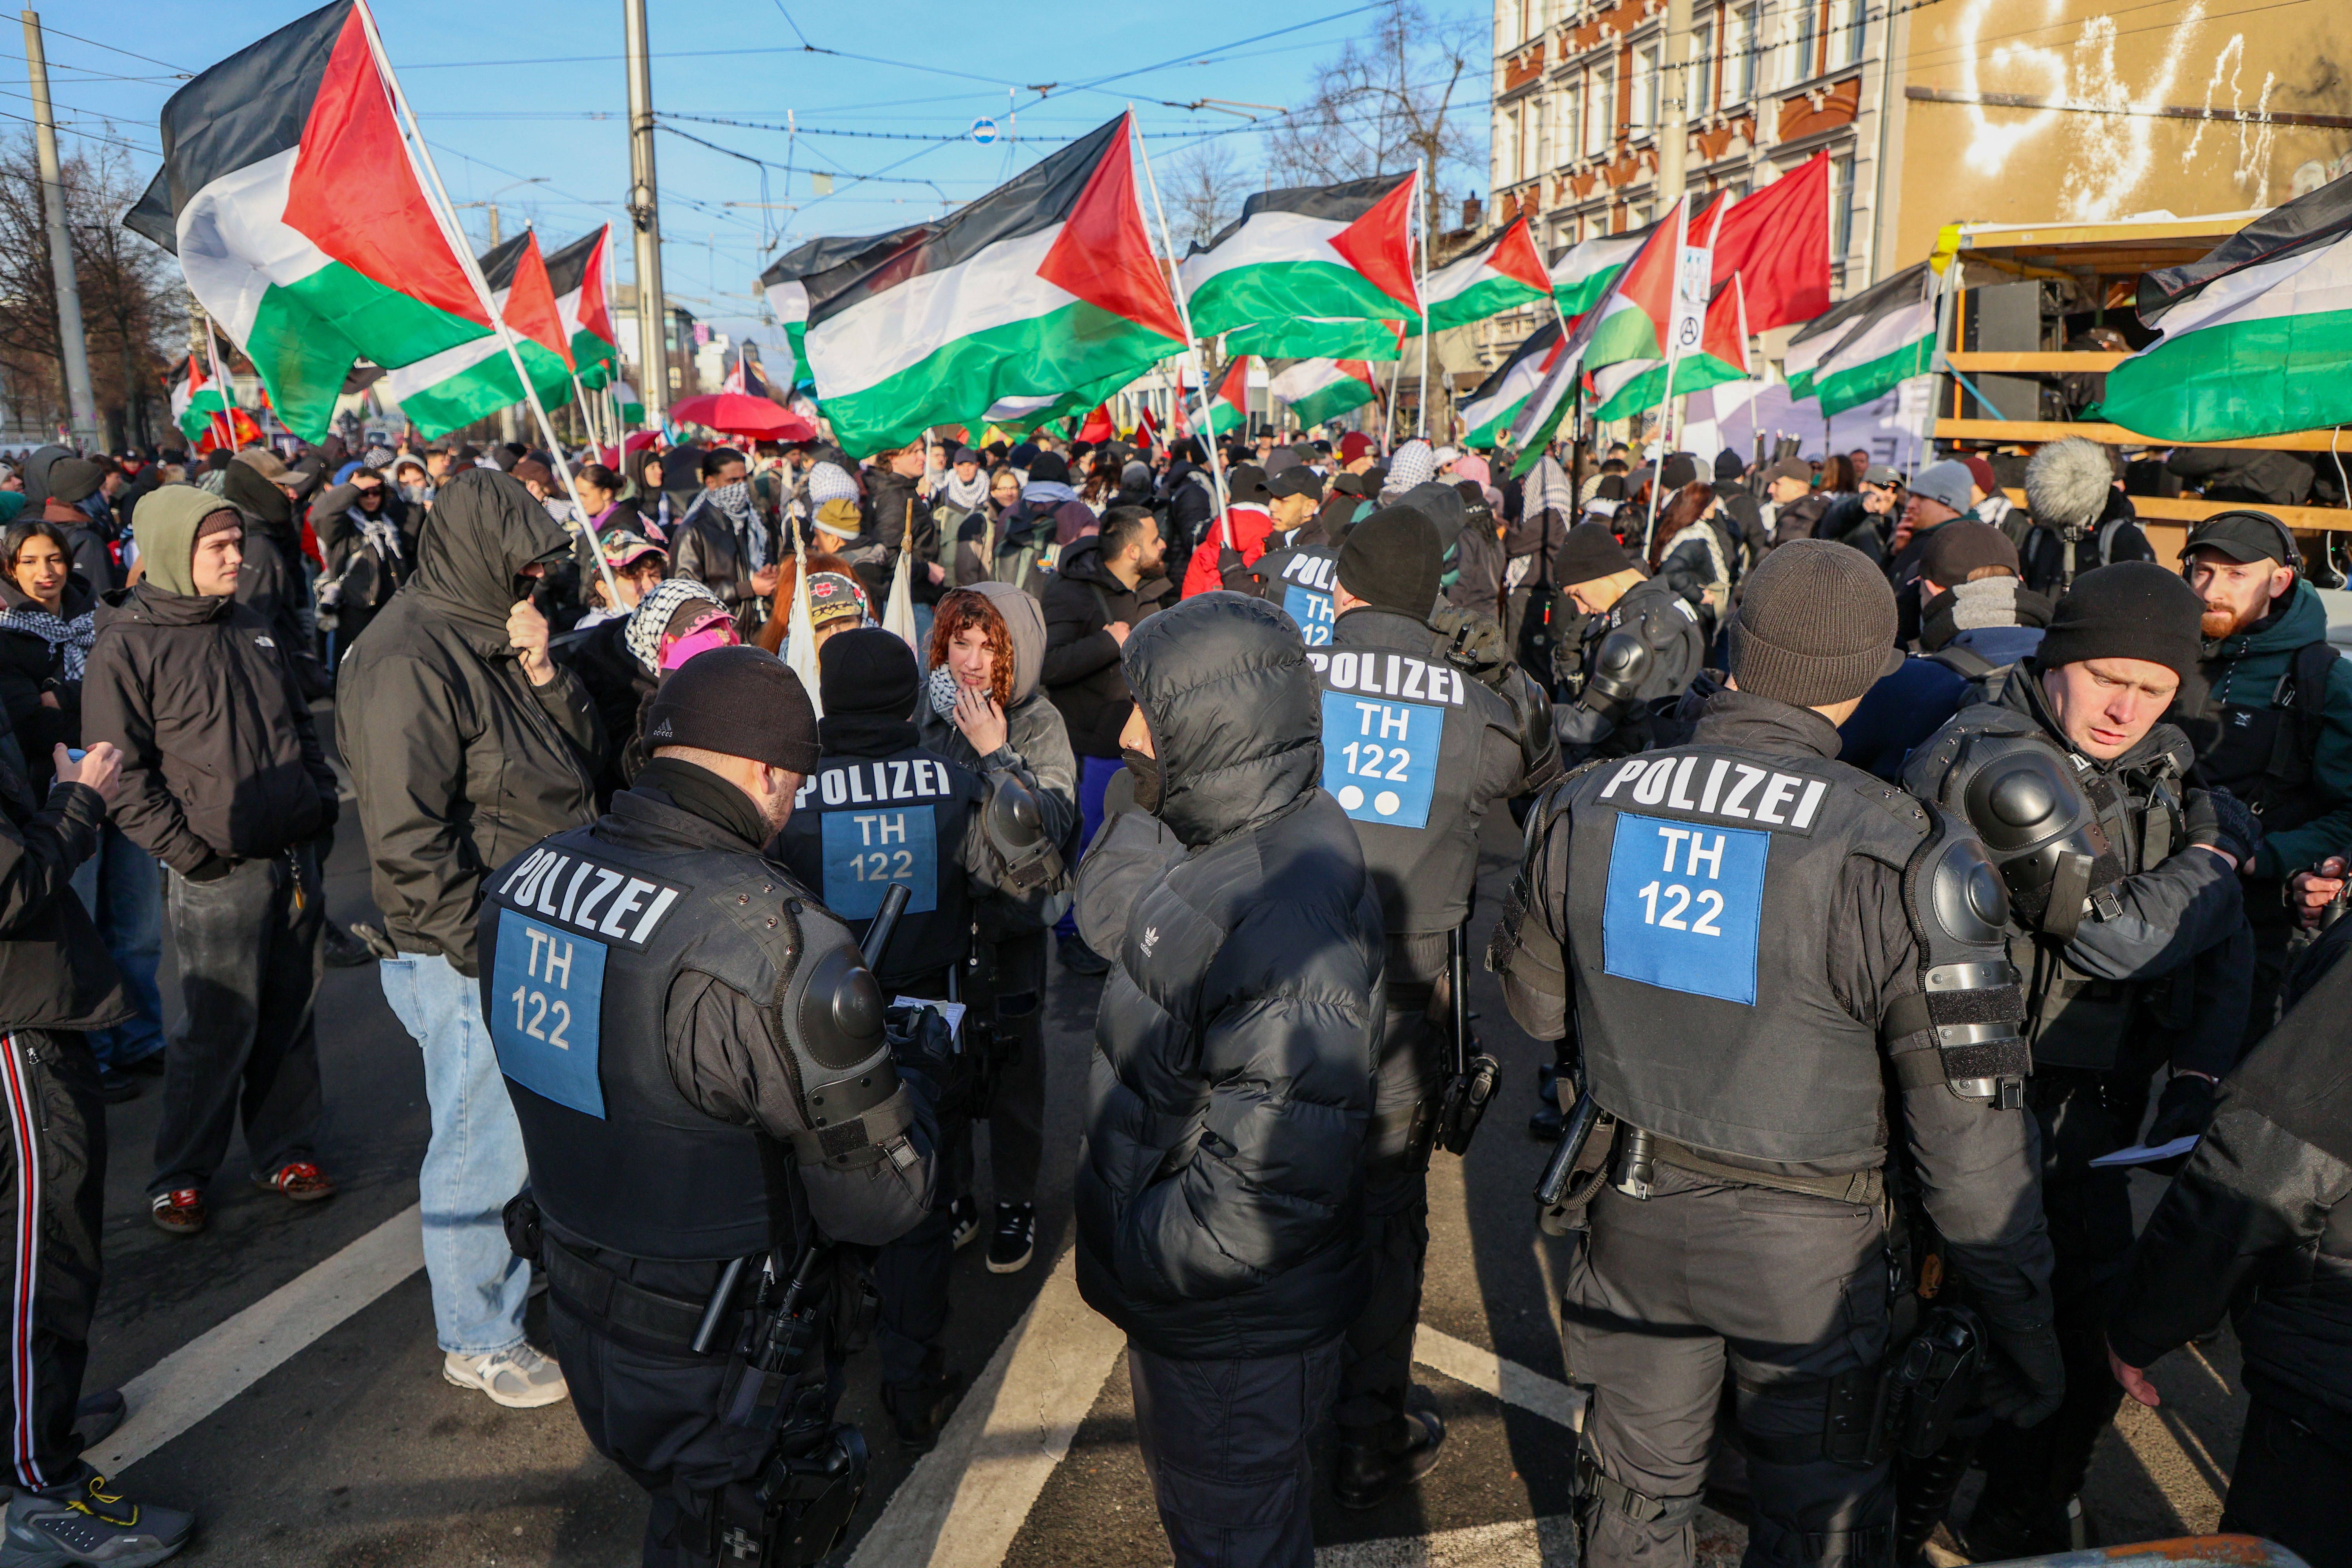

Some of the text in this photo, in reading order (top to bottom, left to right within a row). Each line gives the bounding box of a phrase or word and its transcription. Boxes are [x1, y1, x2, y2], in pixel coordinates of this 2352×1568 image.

[1282, 553, 1338, 591] POLI
[1306, 593, 1335, 624] TH
[1303, 623, 1329, 646] 12
[1306, 652, 1464, 705] POLIZEI
[1356, 701, 1410, 741] TH
[795, 759, 950, 809] POLIZEI
[1342, 742, 1410, 782] 122
[1600, 757, 1827, 828] POLIZEI
[853, 813, 906, 846] TH
[1659, 827, 1725, 879] TH
[849, 850, 913, 882] 122
[498, 848, 679, 944] POLIZEI
[1639, 880, 1724, 936] 122
[525, 927, 573, 990] TH
[512, 985, 570, 1051] 122
